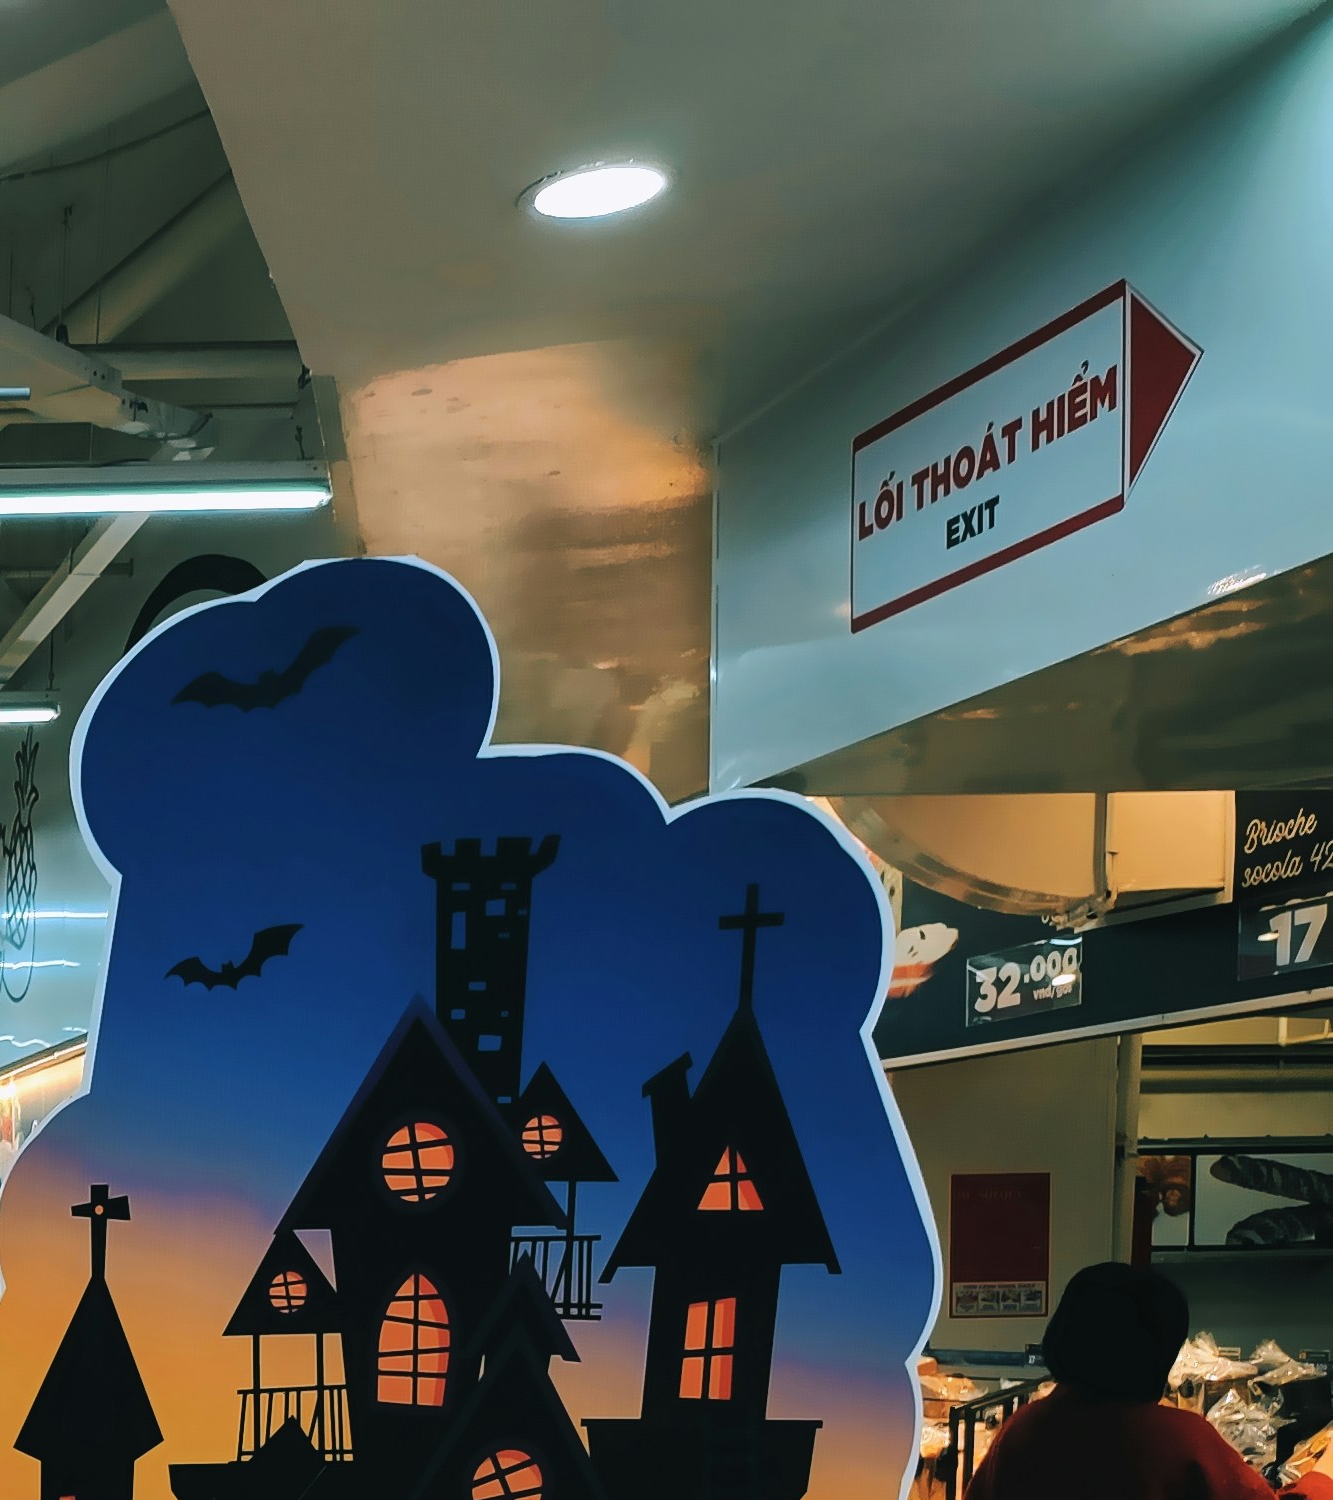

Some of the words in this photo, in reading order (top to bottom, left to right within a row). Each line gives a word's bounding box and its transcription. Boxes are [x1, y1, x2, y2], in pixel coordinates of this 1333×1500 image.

[857, 470, 904, 542] LỐI
[911, 420, 1023, 513] THOÁT
[1030, 359, 1119, 453] HIỂM
[945, 494, 1000, 550] EXIT
[1243, 807, 1318, 856] Brioche
[1241, 848, 1305, 889] socola
[974, 946, 1079, 1013] 32.000
